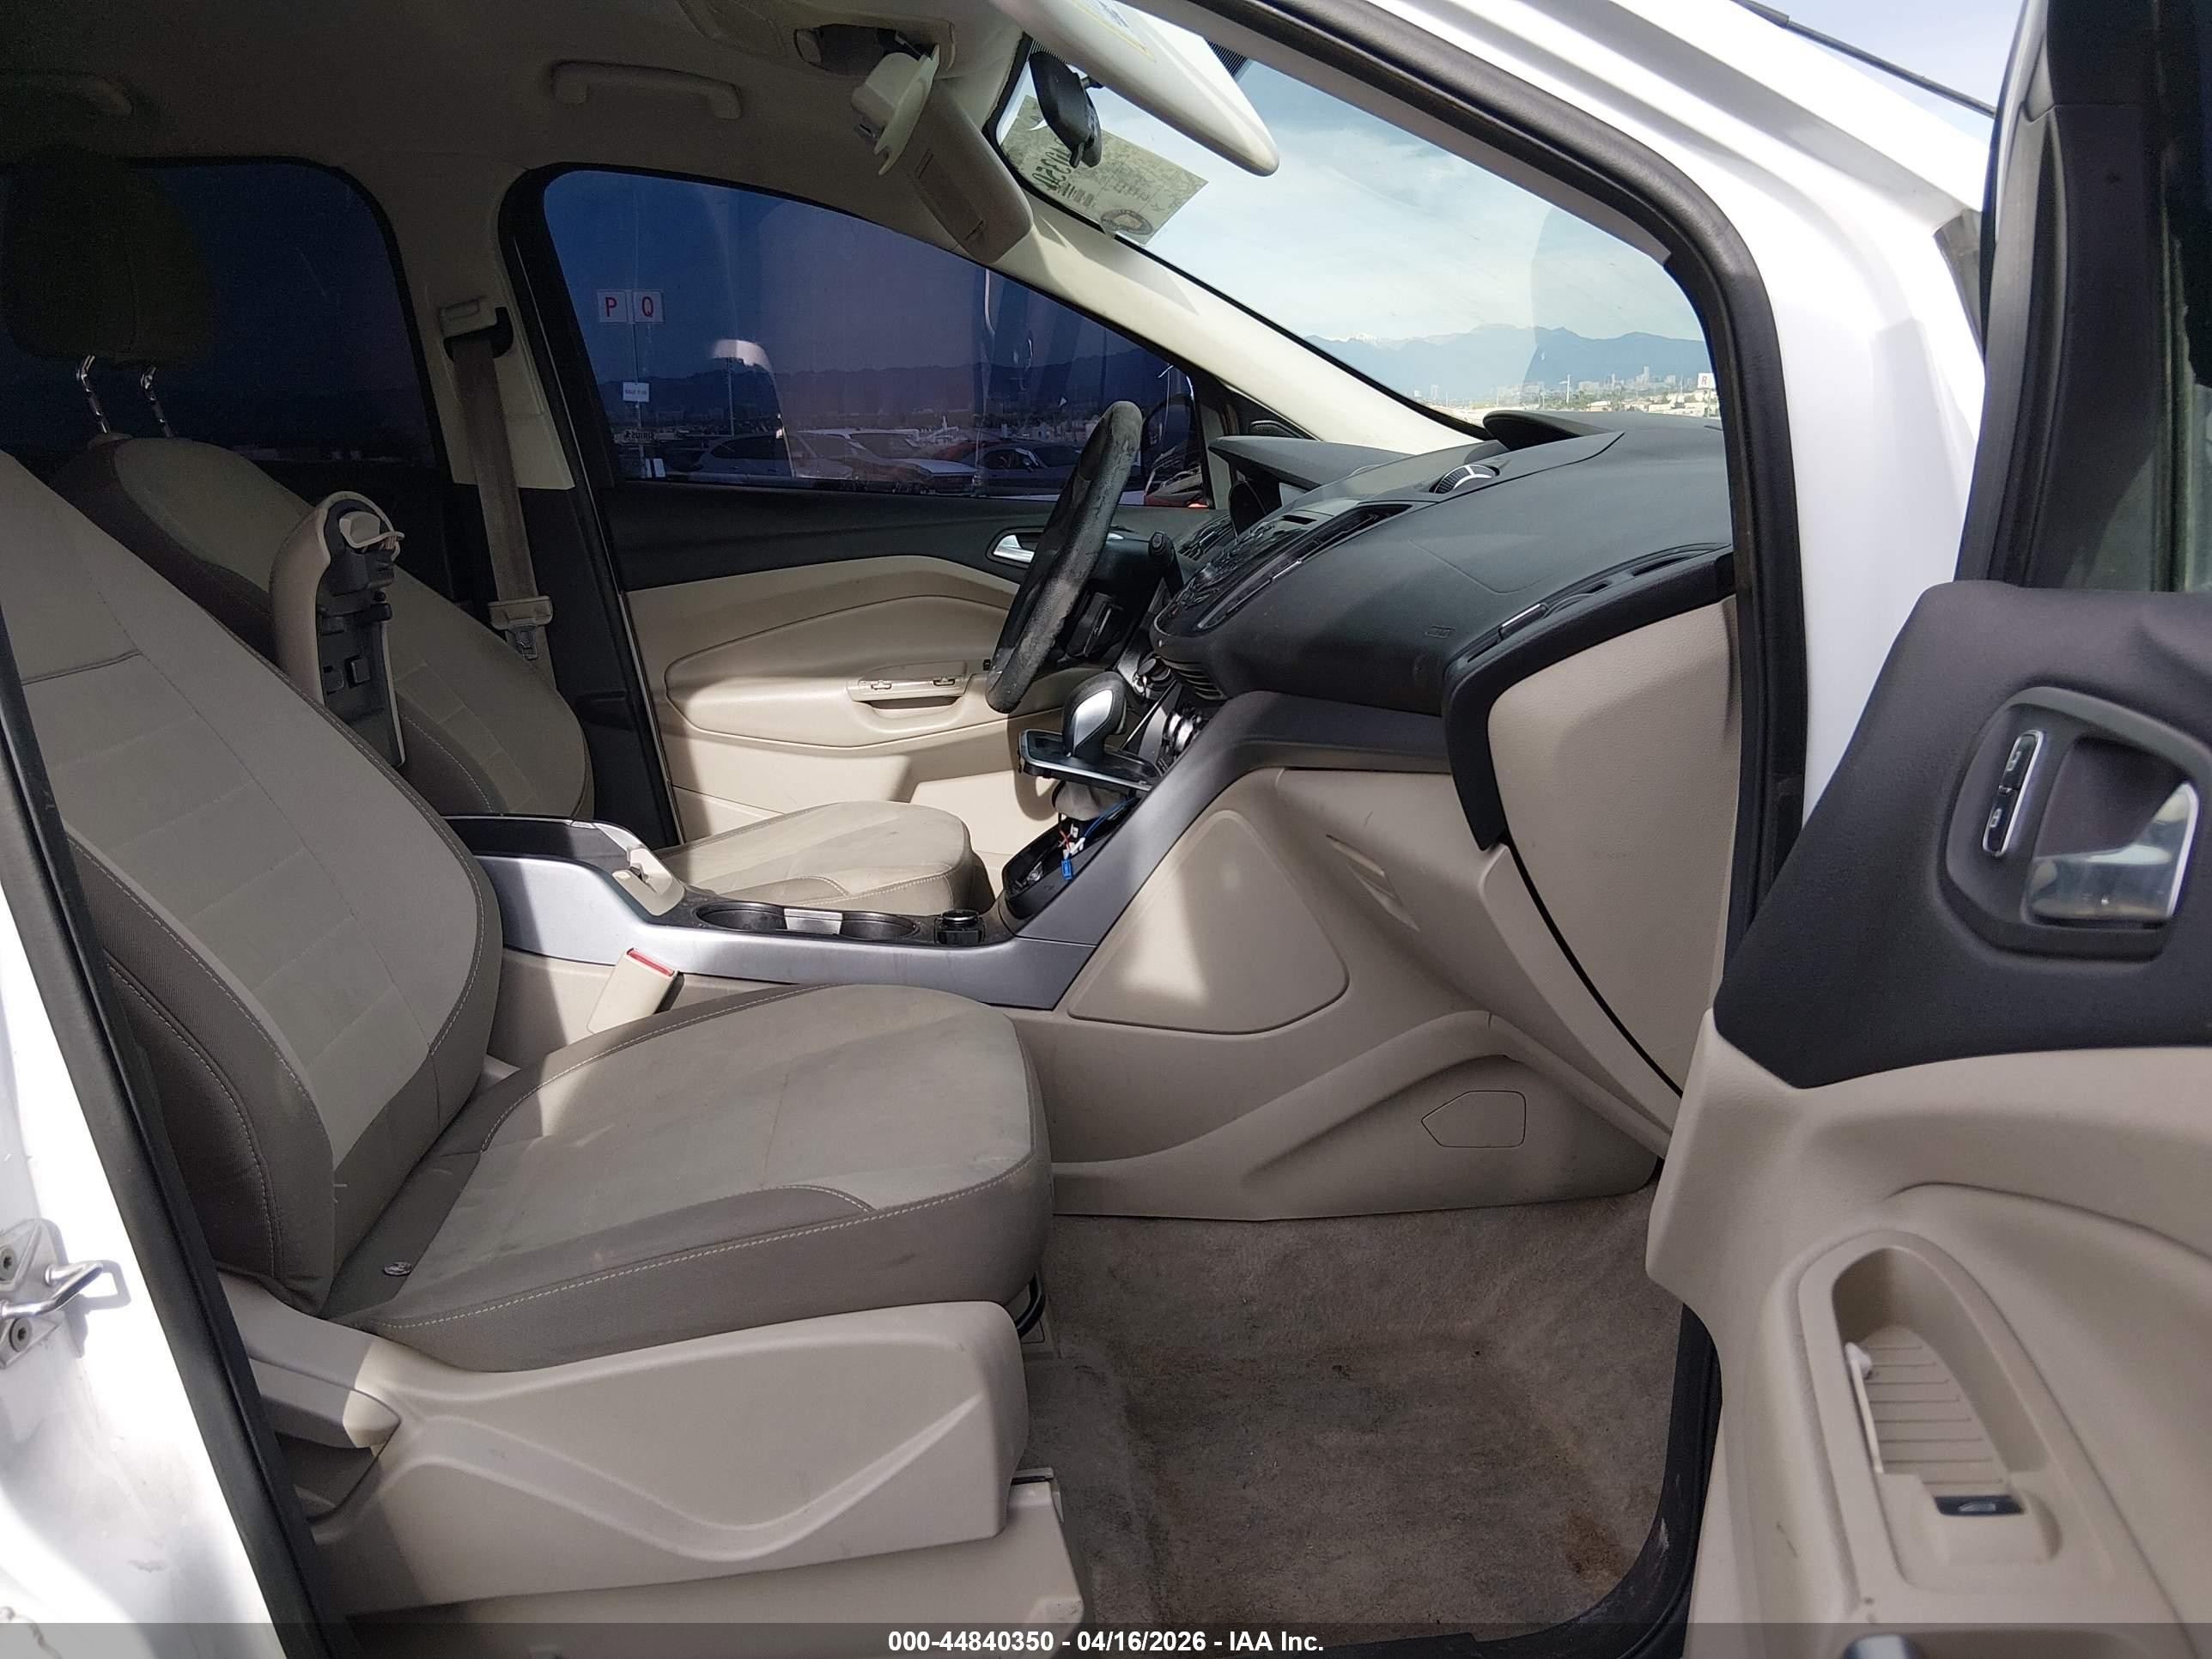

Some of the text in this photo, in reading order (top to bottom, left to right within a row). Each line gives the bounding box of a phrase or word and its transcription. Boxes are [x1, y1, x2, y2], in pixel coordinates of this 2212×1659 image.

[605, 296, 617, 317] P
[641, 296, 653, 318] Q
[1701, 375, 1708, 386] R
